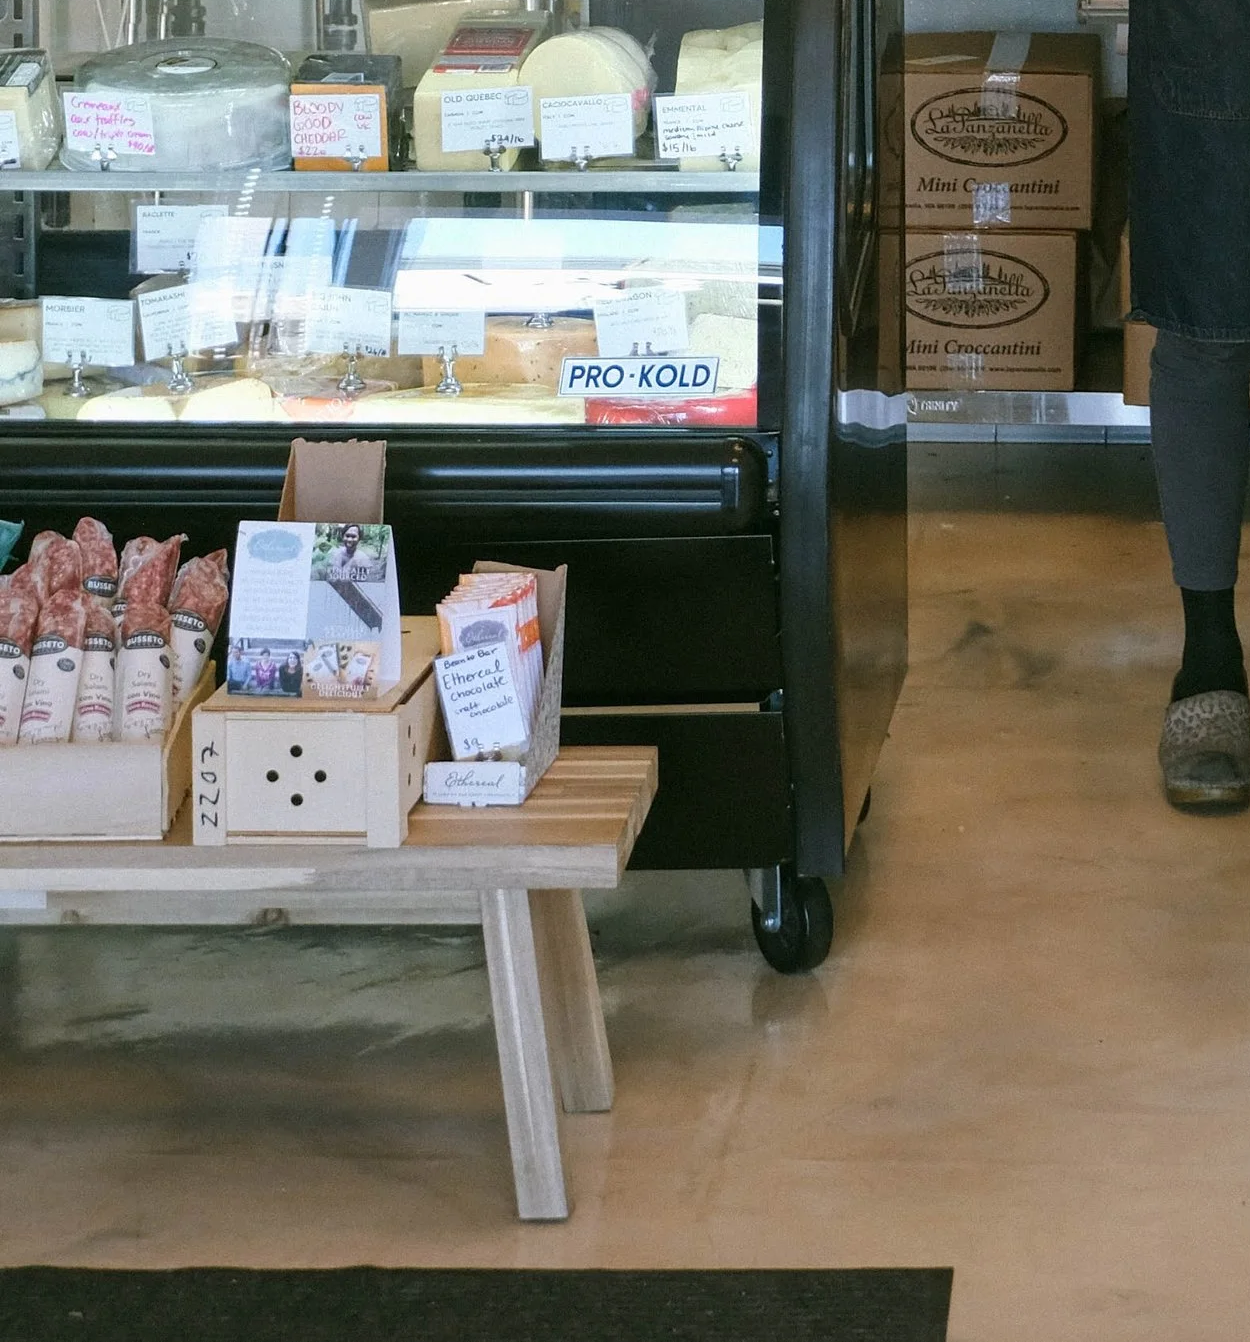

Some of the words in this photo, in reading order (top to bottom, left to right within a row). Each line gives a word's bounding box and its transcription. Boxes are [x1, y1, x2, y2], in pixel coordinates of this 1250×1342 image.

[444, 96, 463, 104] OLD
[465, 92, 502, 102] QUEBEC
[293, 100, 344, 116] BLOODY
[662, 104, 707, 114] EMMENTAL
[293, 116, 332, 132] GOOD
[293, 128, 349, 145] CHEDDAR
[662, 140, 697, 153] $15/lb
[917, 177, 957, 194] Mini
[45, 305, 85, 313] MORBIER
[944, 339, 1041, 356] Croccantini
[87, 578, 114, 592] BUSSE
[442, 659, 505, 691] Ethereal
[444, 770, 505, 790] Ethereal
